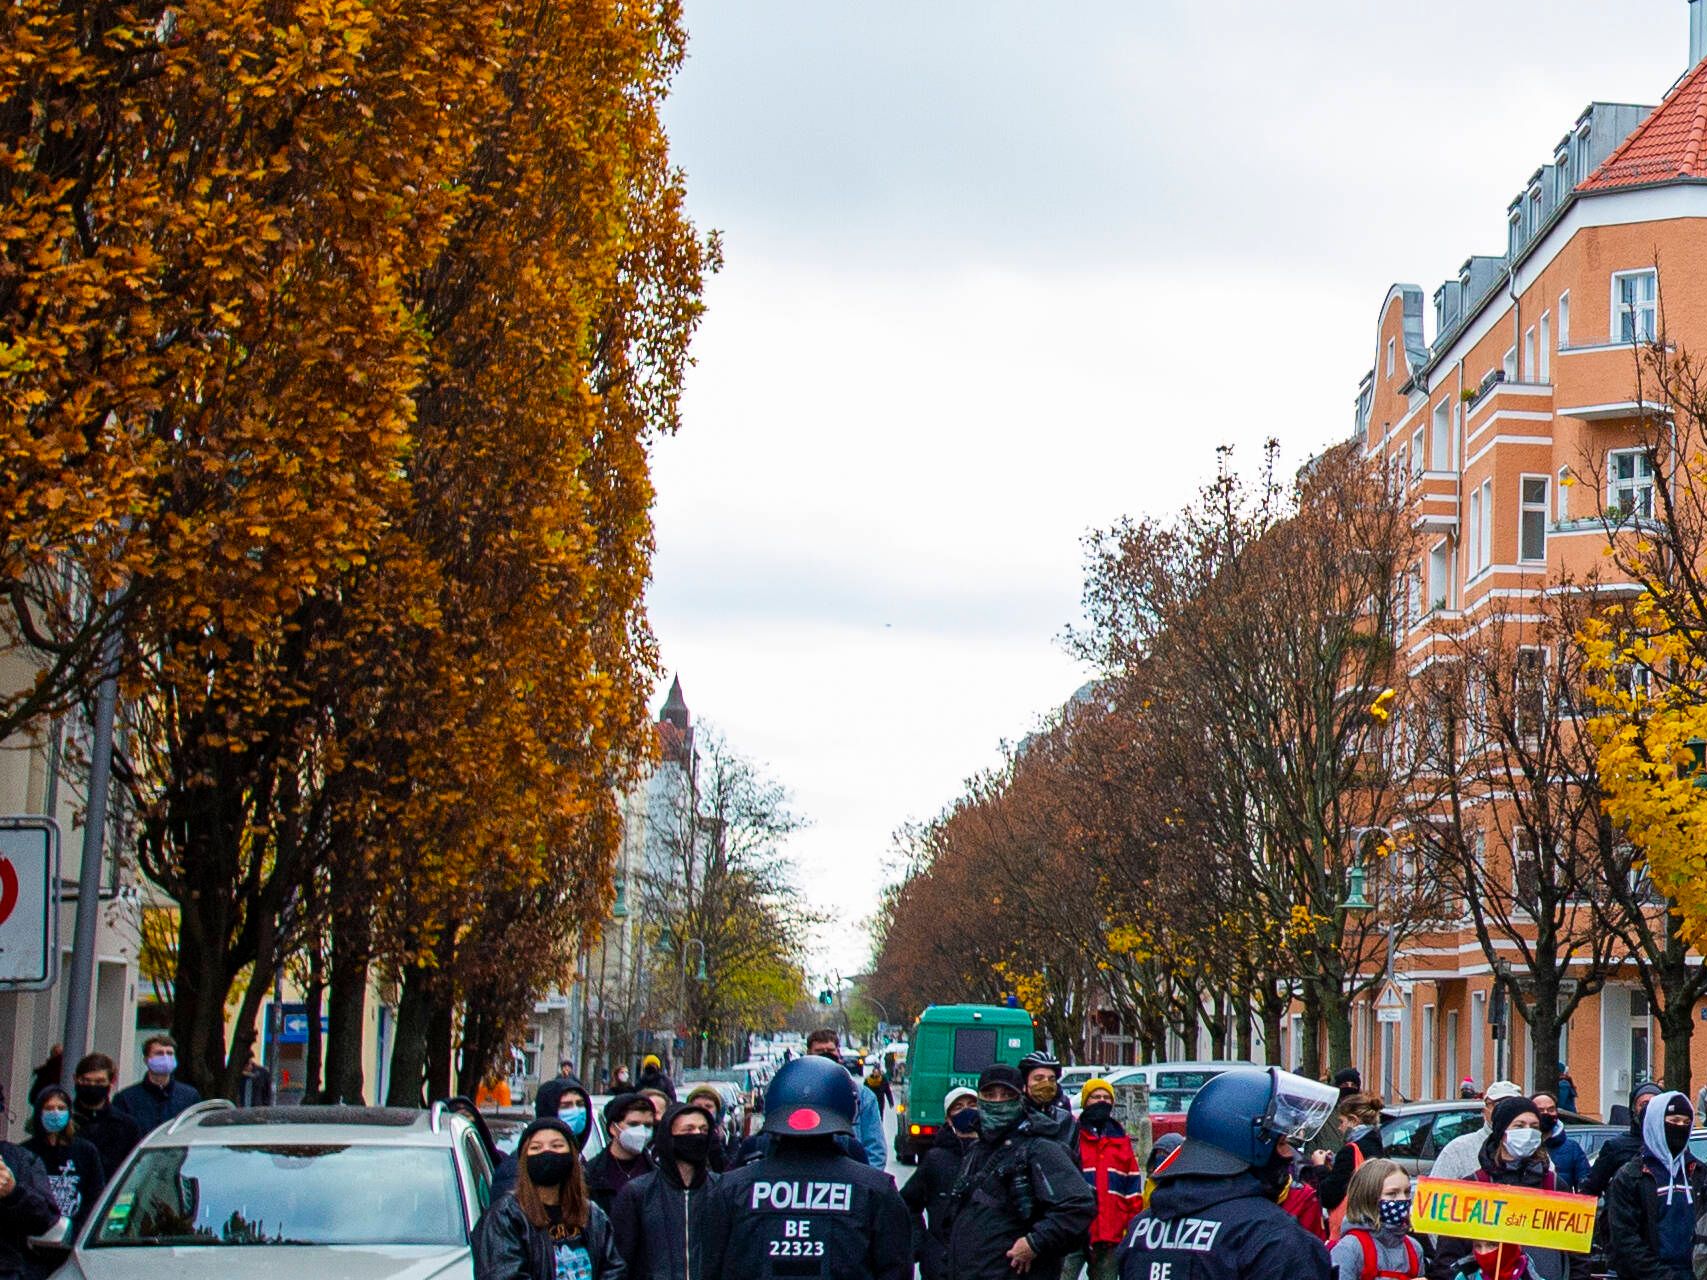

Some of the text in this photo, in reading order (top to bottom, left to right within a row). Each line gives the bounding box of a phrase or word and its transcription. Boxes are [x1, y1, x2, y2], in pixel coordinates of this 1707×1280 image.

[950, 1077, 979, 1087] POLI
[752, 1181, 852, 1210] POLIZEI
[1417, 1191, 1595, 1234] VIELFALT statt EINFALT
[785, 1220, 811, 1237] BE
[1129, 1217, 1222, 1251] POLIZEI
[769, 1241, 825, 1256] 22323
